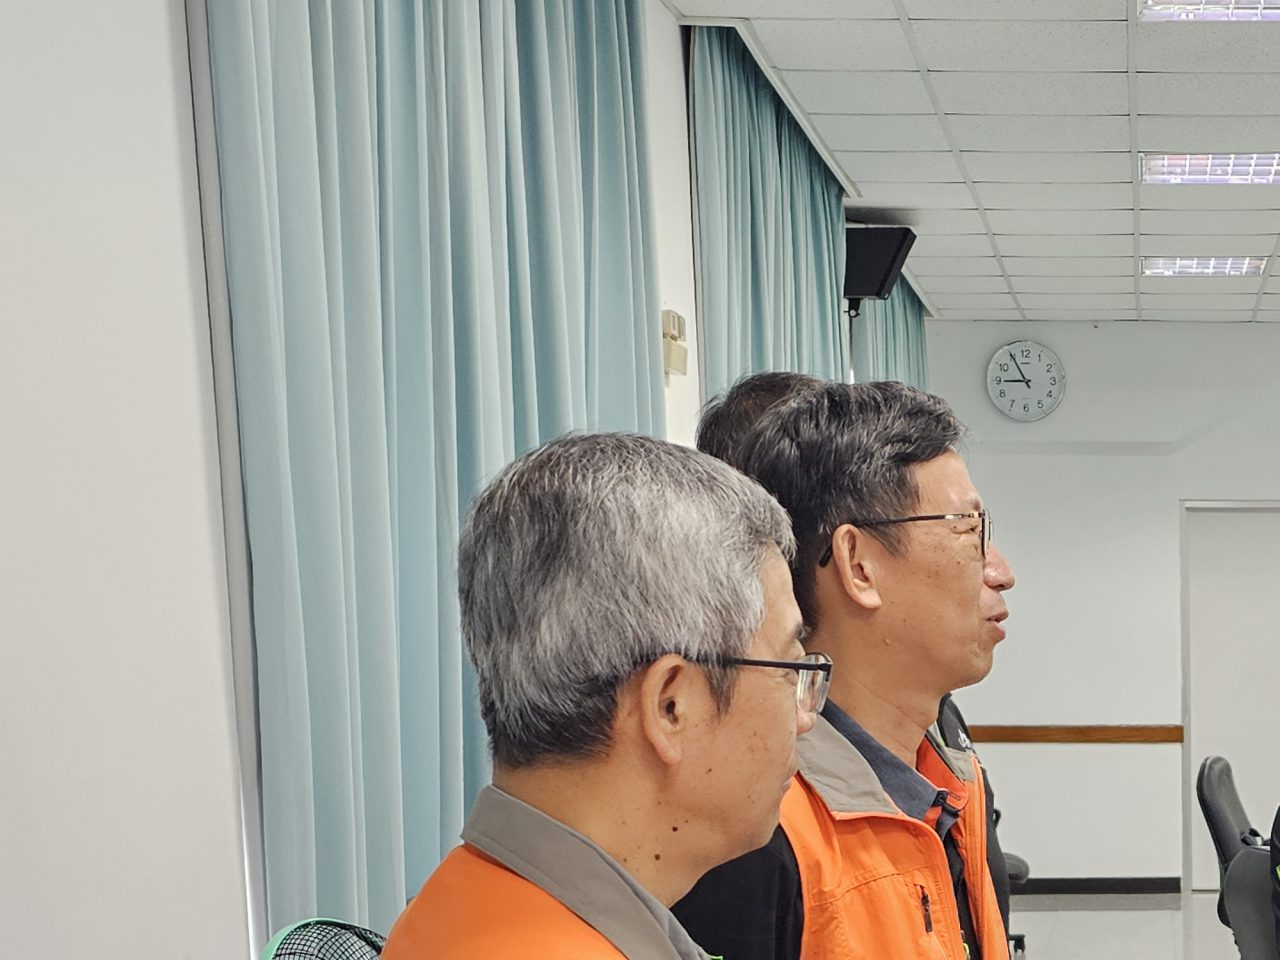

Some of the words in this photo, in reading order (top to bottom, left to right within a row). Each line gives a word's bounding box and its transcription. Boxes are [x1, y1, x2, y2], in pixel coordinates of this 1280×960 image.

[1021, 349, 1031, 359] 12
[999, 363, 1009, 373] 10
[1046, 363, 1053, 373] 2
[995, 376, 1002, 386] 9
[1050, 376, 1057, 386] 3
[999, 389, 1006, 398] 8
[1046, 390, 1053, 398] 4
[1010, 399, 1016, 408] 7
[1037, 400, 1044, 409] 5
[1023, 404, 1030, 413] 6
